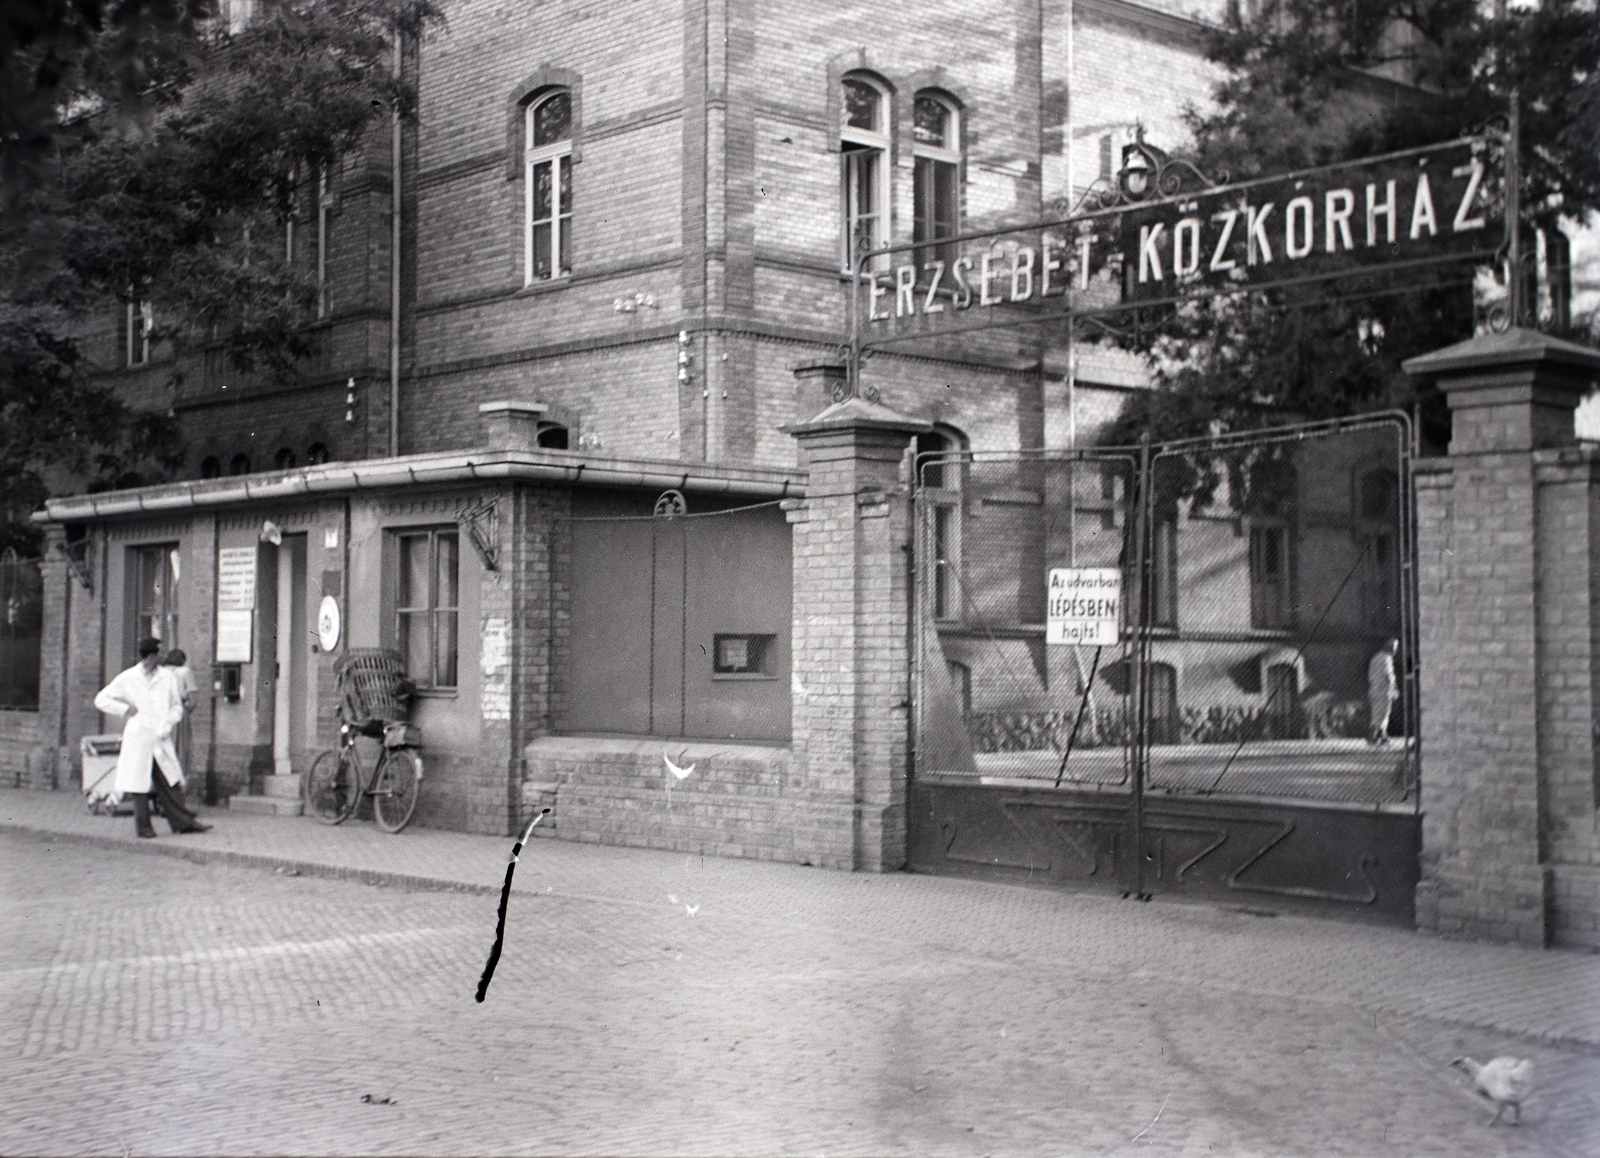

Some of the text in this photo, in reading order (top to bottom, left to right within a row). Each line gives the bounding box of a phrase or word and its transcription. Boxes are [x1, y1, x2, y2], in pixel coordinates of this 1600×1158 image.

[1138, 157, 1486, 283] KÖZKÓRHÁZ
[1050, 593, 1115, 616] LÉPÉSBEN
[1062, 622, 1100, 644] hajts!
